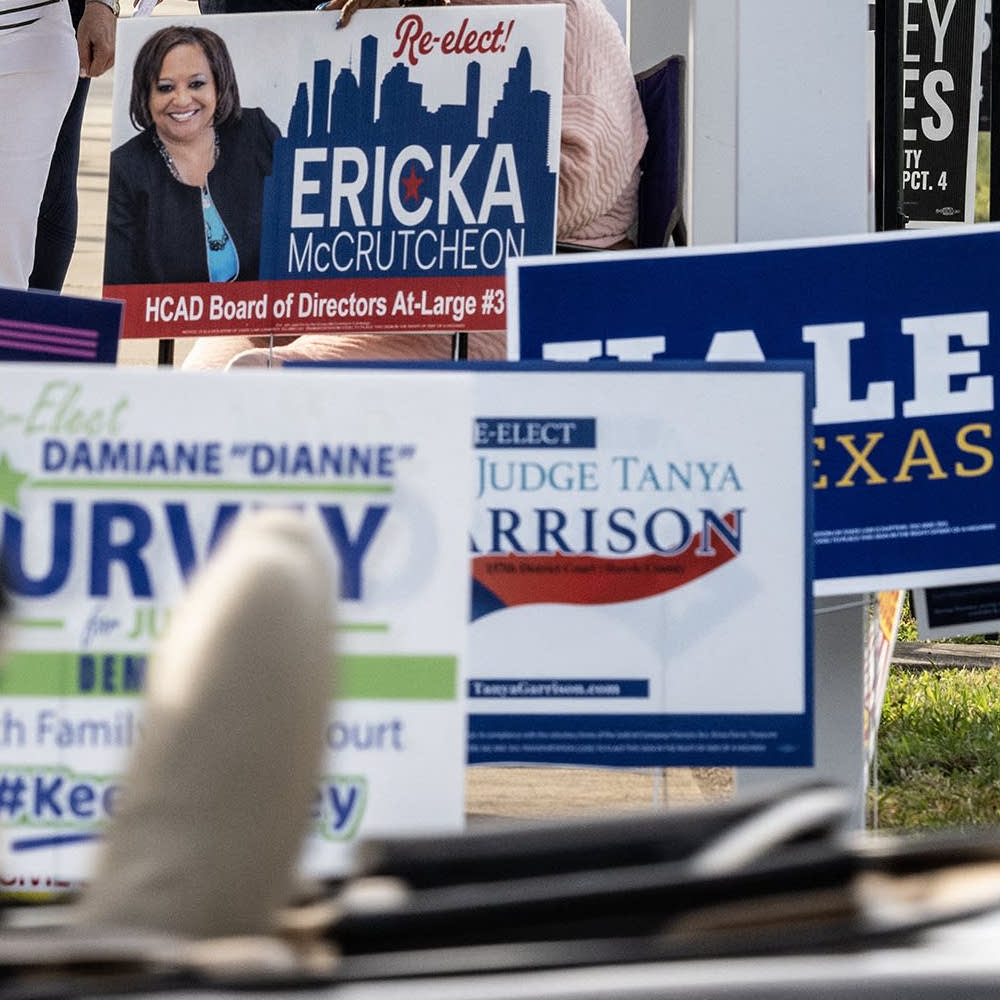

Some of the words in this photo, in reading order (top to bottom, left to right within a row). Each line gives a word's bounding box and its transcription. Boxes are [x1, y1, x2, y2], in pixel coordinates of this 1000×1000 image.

[393, 14, 516, 66] Re-elect!
[904, 69, 954, 142] ES
[902, 170, 933, 191] PCT.
[938, 171, 948, 191] 4
[904, 149, 922, 169] TY
[291, 143, 525, 229] ERICKA
[288, 228, 525, 273] McCRUTCHEON
[145, 295, 203, 322] HCAD
[208, 292, 267, 321] Board
[273, 291, 294, 319] of
[298, 290, 388, 318] Directors
[391, 288, 476, 323] At-Large
[482, 288, 505, 315] #3
[542, 311, 995, 425] LE
[475, 422, 577, 445] E-ELECT
[41, 440, 222, 475] DAMIANE
[477, 456, 598, 499] JUDGE
[612, 456, 744, 492] TANYA
[813, 424, 994, 489] EXAS
[129, 607, 174, 640] JU
[472, 681, 621, 698] TanyaGarrison.com
[36, 708, 136, 748] Famil
[326, 716, 405, 751] ourt
